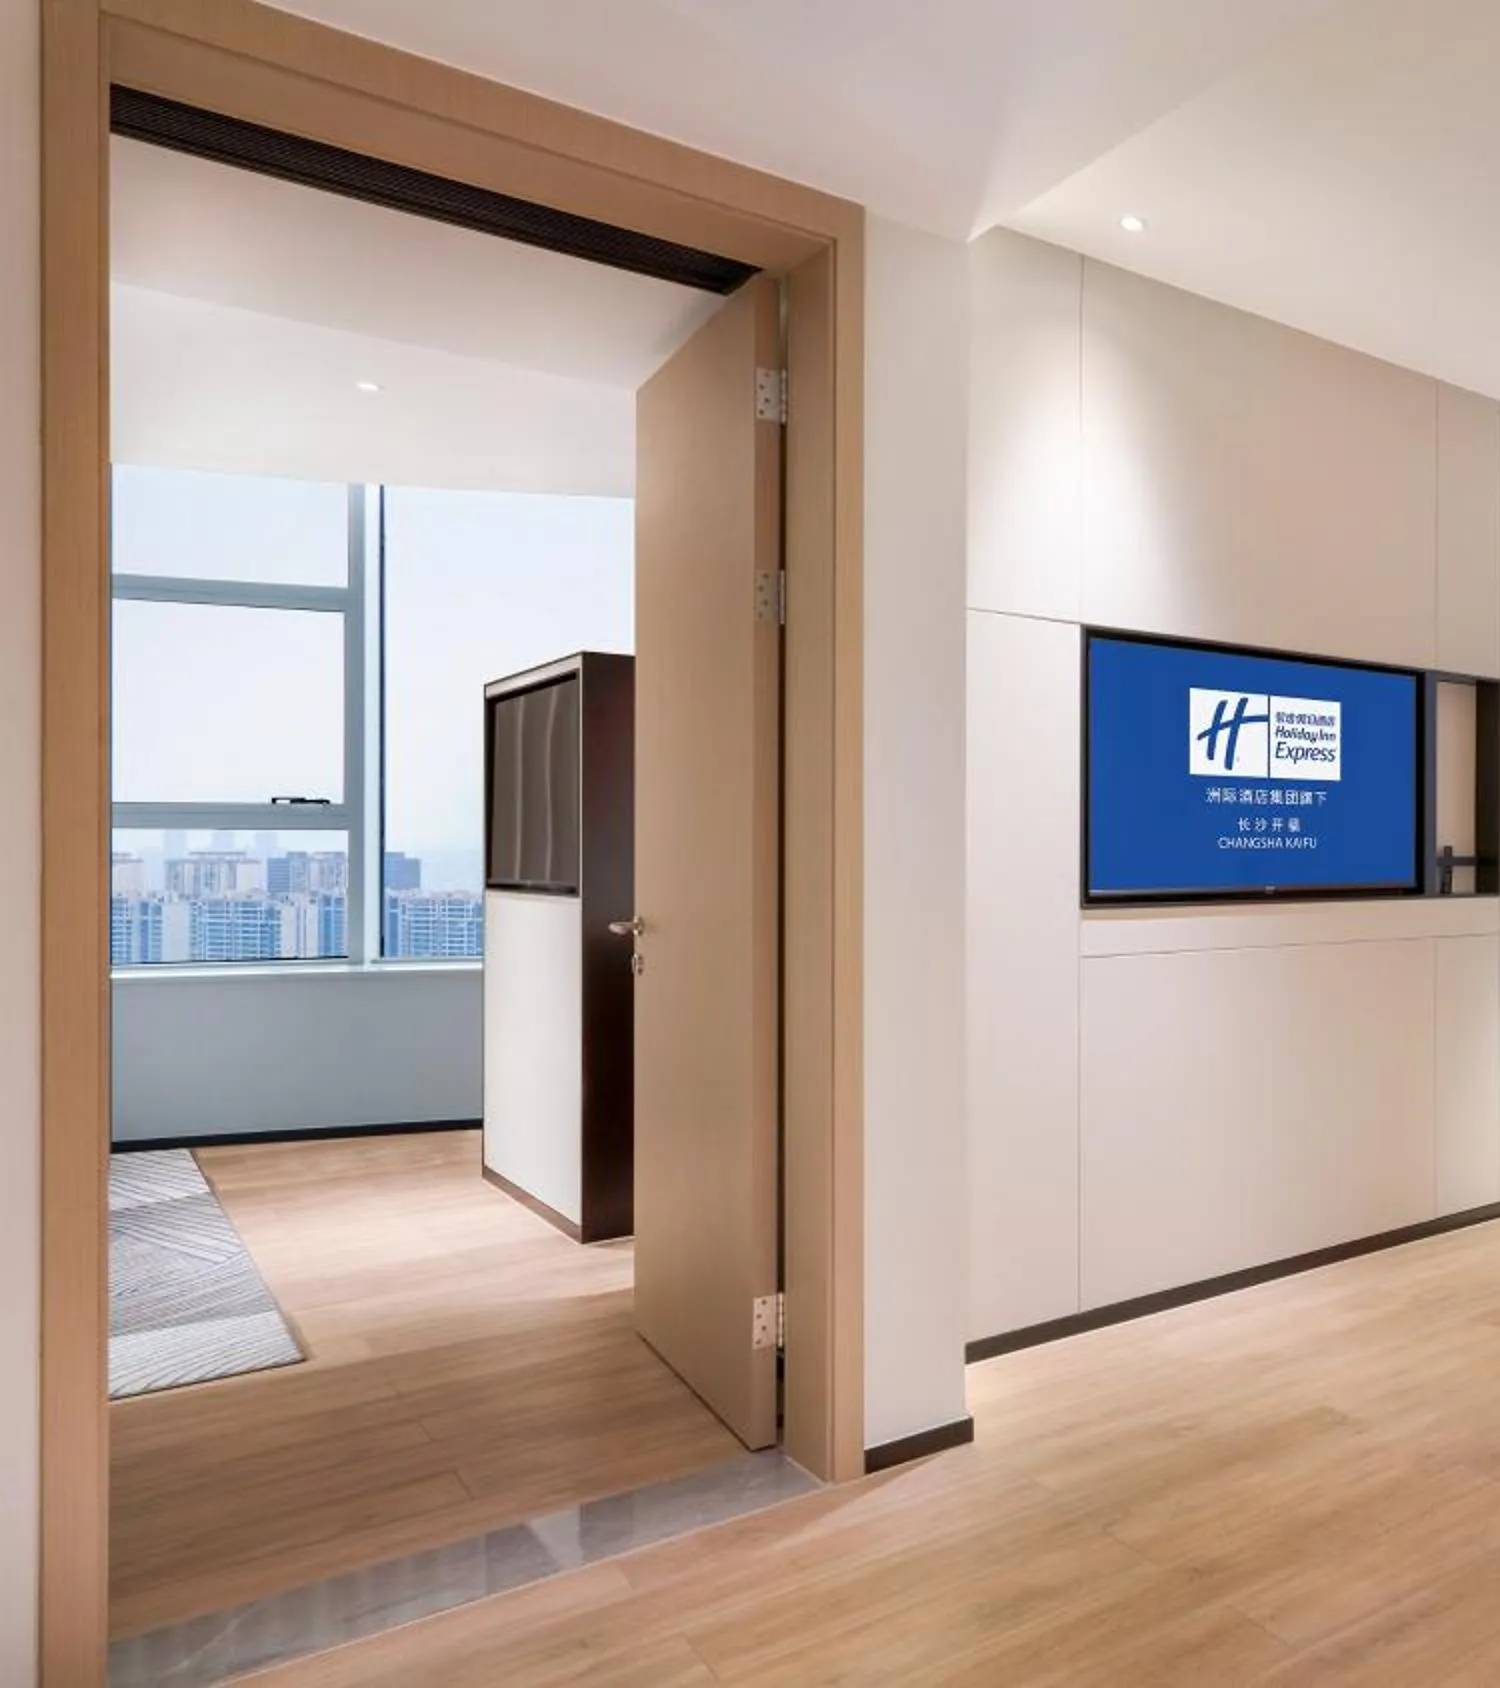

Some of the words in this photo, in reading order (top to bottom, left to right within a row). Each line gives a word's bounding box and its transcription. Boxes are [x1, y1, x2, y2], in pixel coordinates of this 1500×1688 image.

[1275, 726, 1317, 744] Holiday
[1319, 728, 1336, 741] Inn
[1275, 741, 1336, 764] Express
[1218, 837, 1283, 849] CHANGSHA
[1285, 837, 1317, 849] KAIFU
